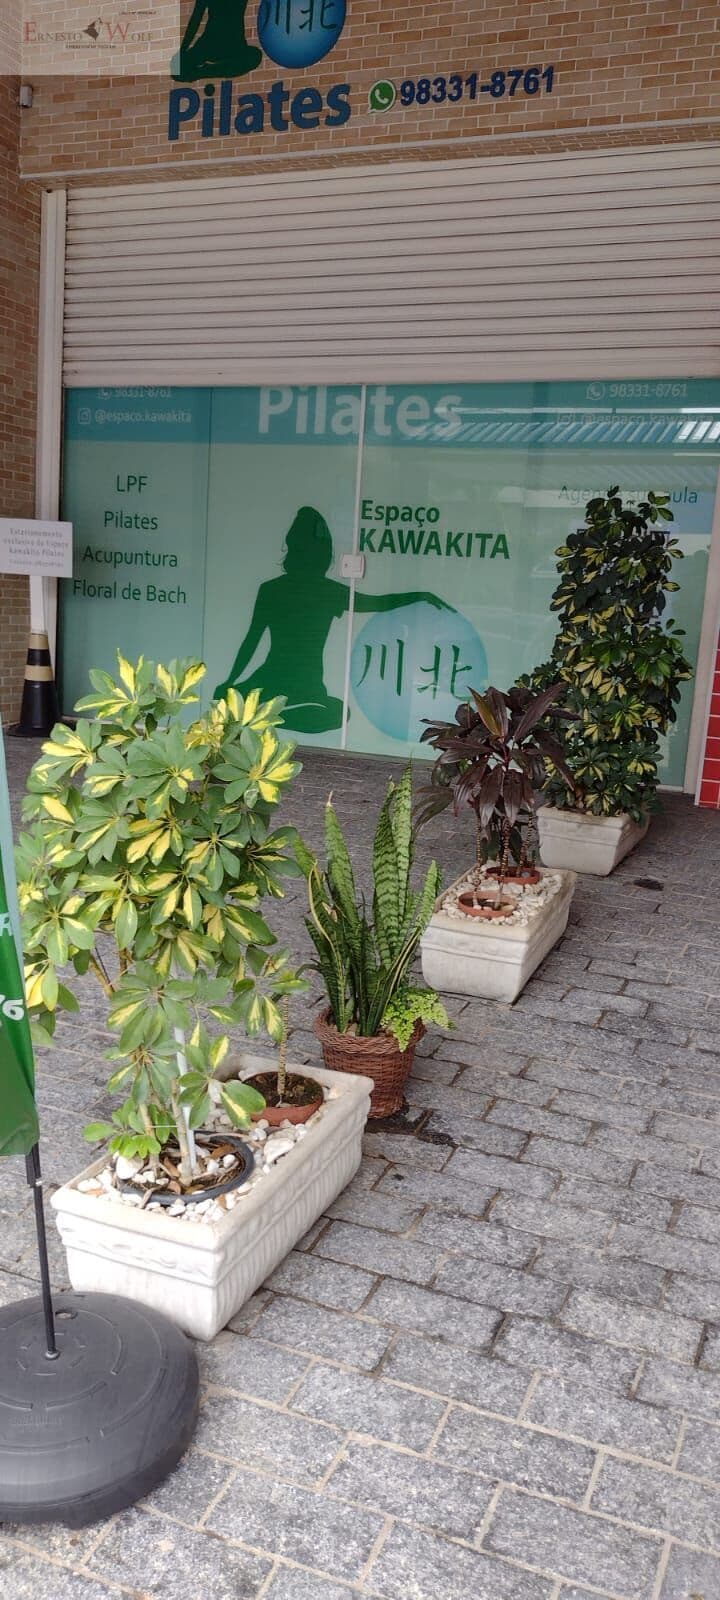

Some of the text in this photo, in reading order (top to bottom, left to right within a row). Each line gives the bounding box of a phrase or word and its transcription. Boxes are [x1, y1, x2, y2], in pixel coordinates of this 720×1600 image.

[167, 66, 555, 141] Pilates 98331-8761
[609, 383, 688, 398] 98331-8761
[257, 385, 464, 438] Pilates
[116, 474, 149, 493] LPF
[103, 509, 159, 530] Pilates
[360, 499, 441, 528] Espaço
[358, 527, 511, 560] KAWAKITA
[82, 544, 178, 569] Acupuntura
[72, 579, 187, 604] Floral de Bach
